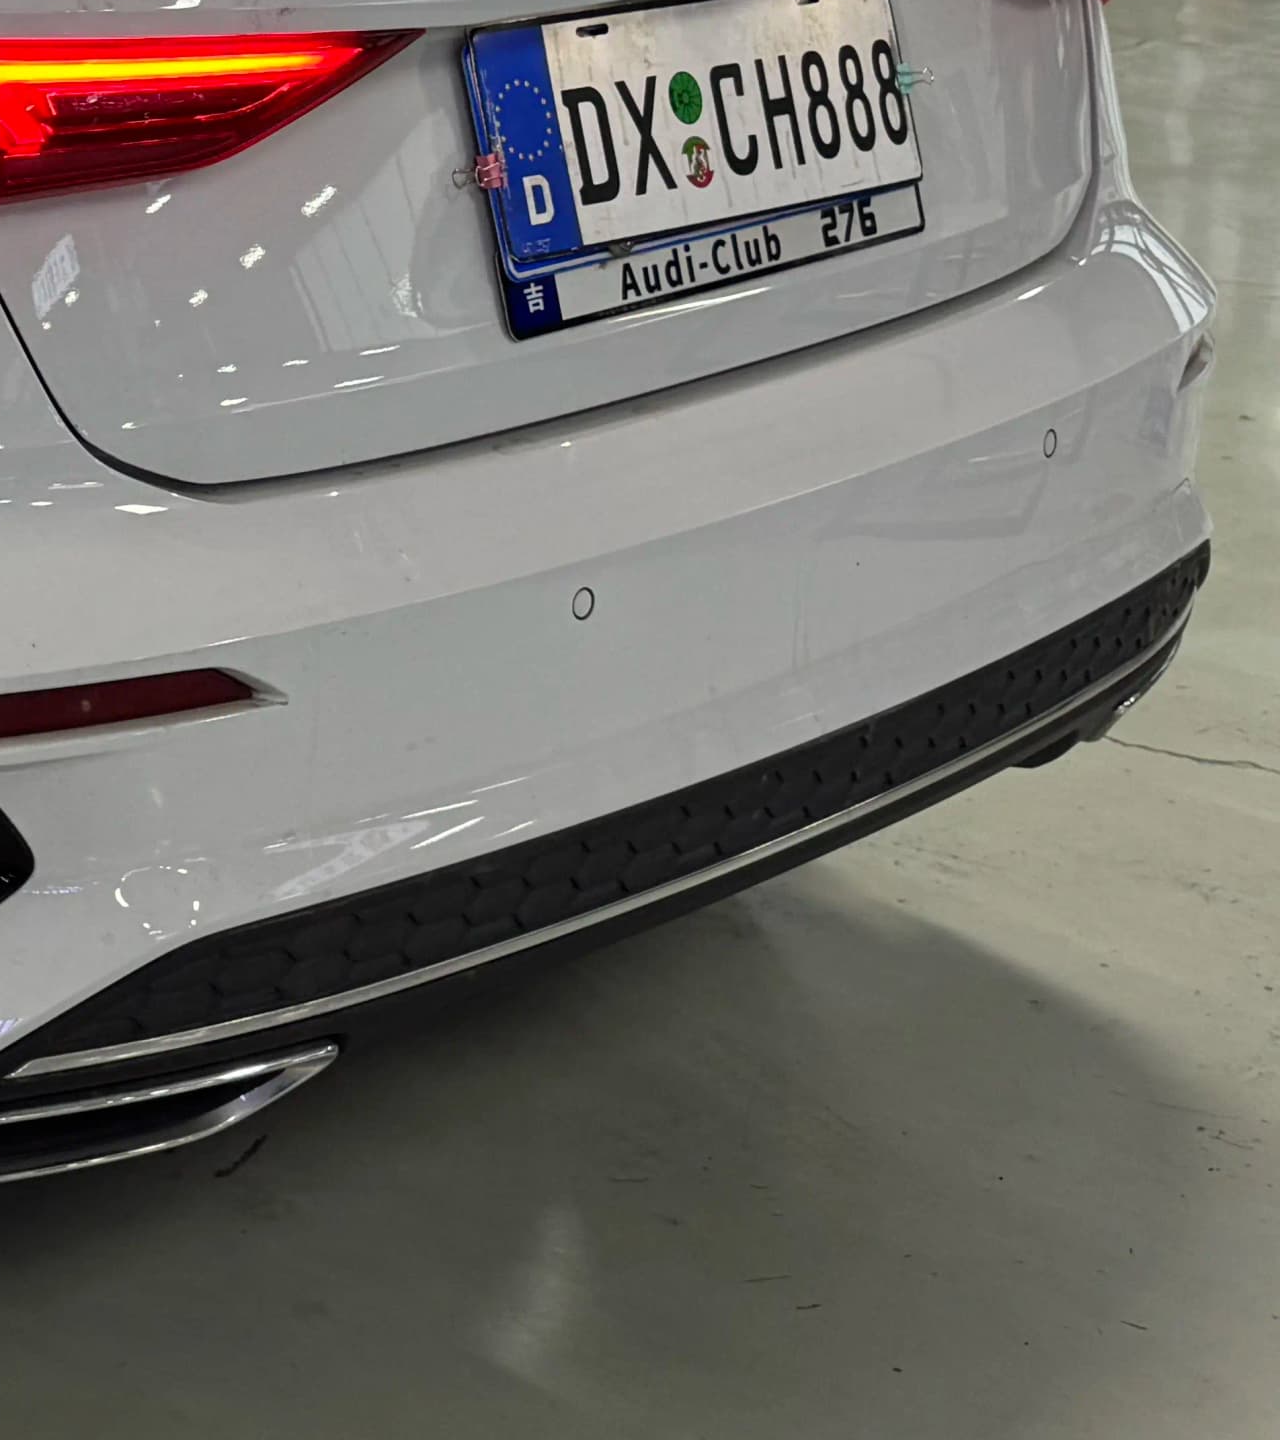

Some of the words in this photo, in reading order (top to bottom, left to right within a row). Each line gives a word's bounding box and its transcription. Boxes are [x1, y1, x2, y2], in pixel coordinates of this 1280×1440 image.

[560, 74, 678, 207] DX
[709, 38, 909, 177] CH888
[523, 174, 555, 227] D
[621, 224, 783, 301] Audi-Club
[820, 198, 878, 248] 276
[523, 281, 545, 314] 吉
